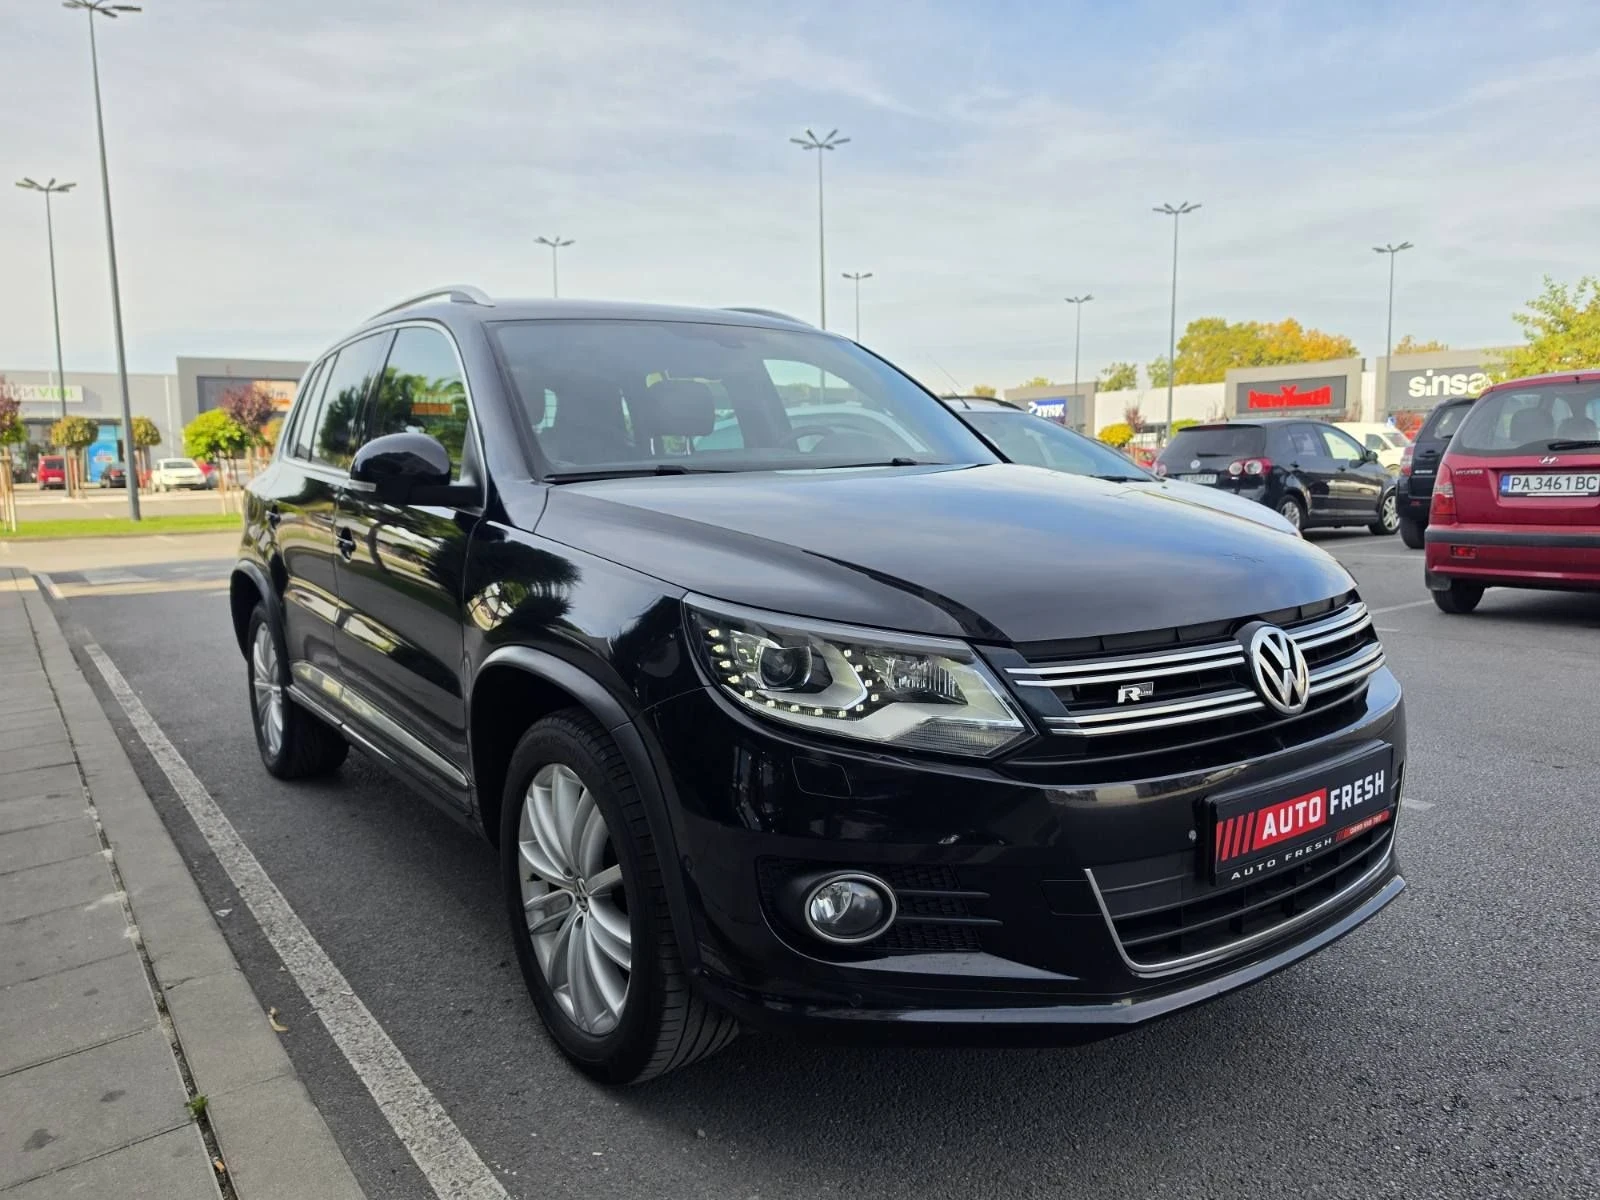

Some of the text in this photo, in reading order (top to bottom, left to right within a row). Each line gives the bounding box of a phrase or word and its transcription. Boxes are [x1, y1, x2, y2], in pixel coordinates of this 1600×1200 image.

[1262, 796, 1321, 840] AUTO
[1329, 769, 1385, 816] FRESH
[1231, 837, 1332, 880] AUTO FRESH
